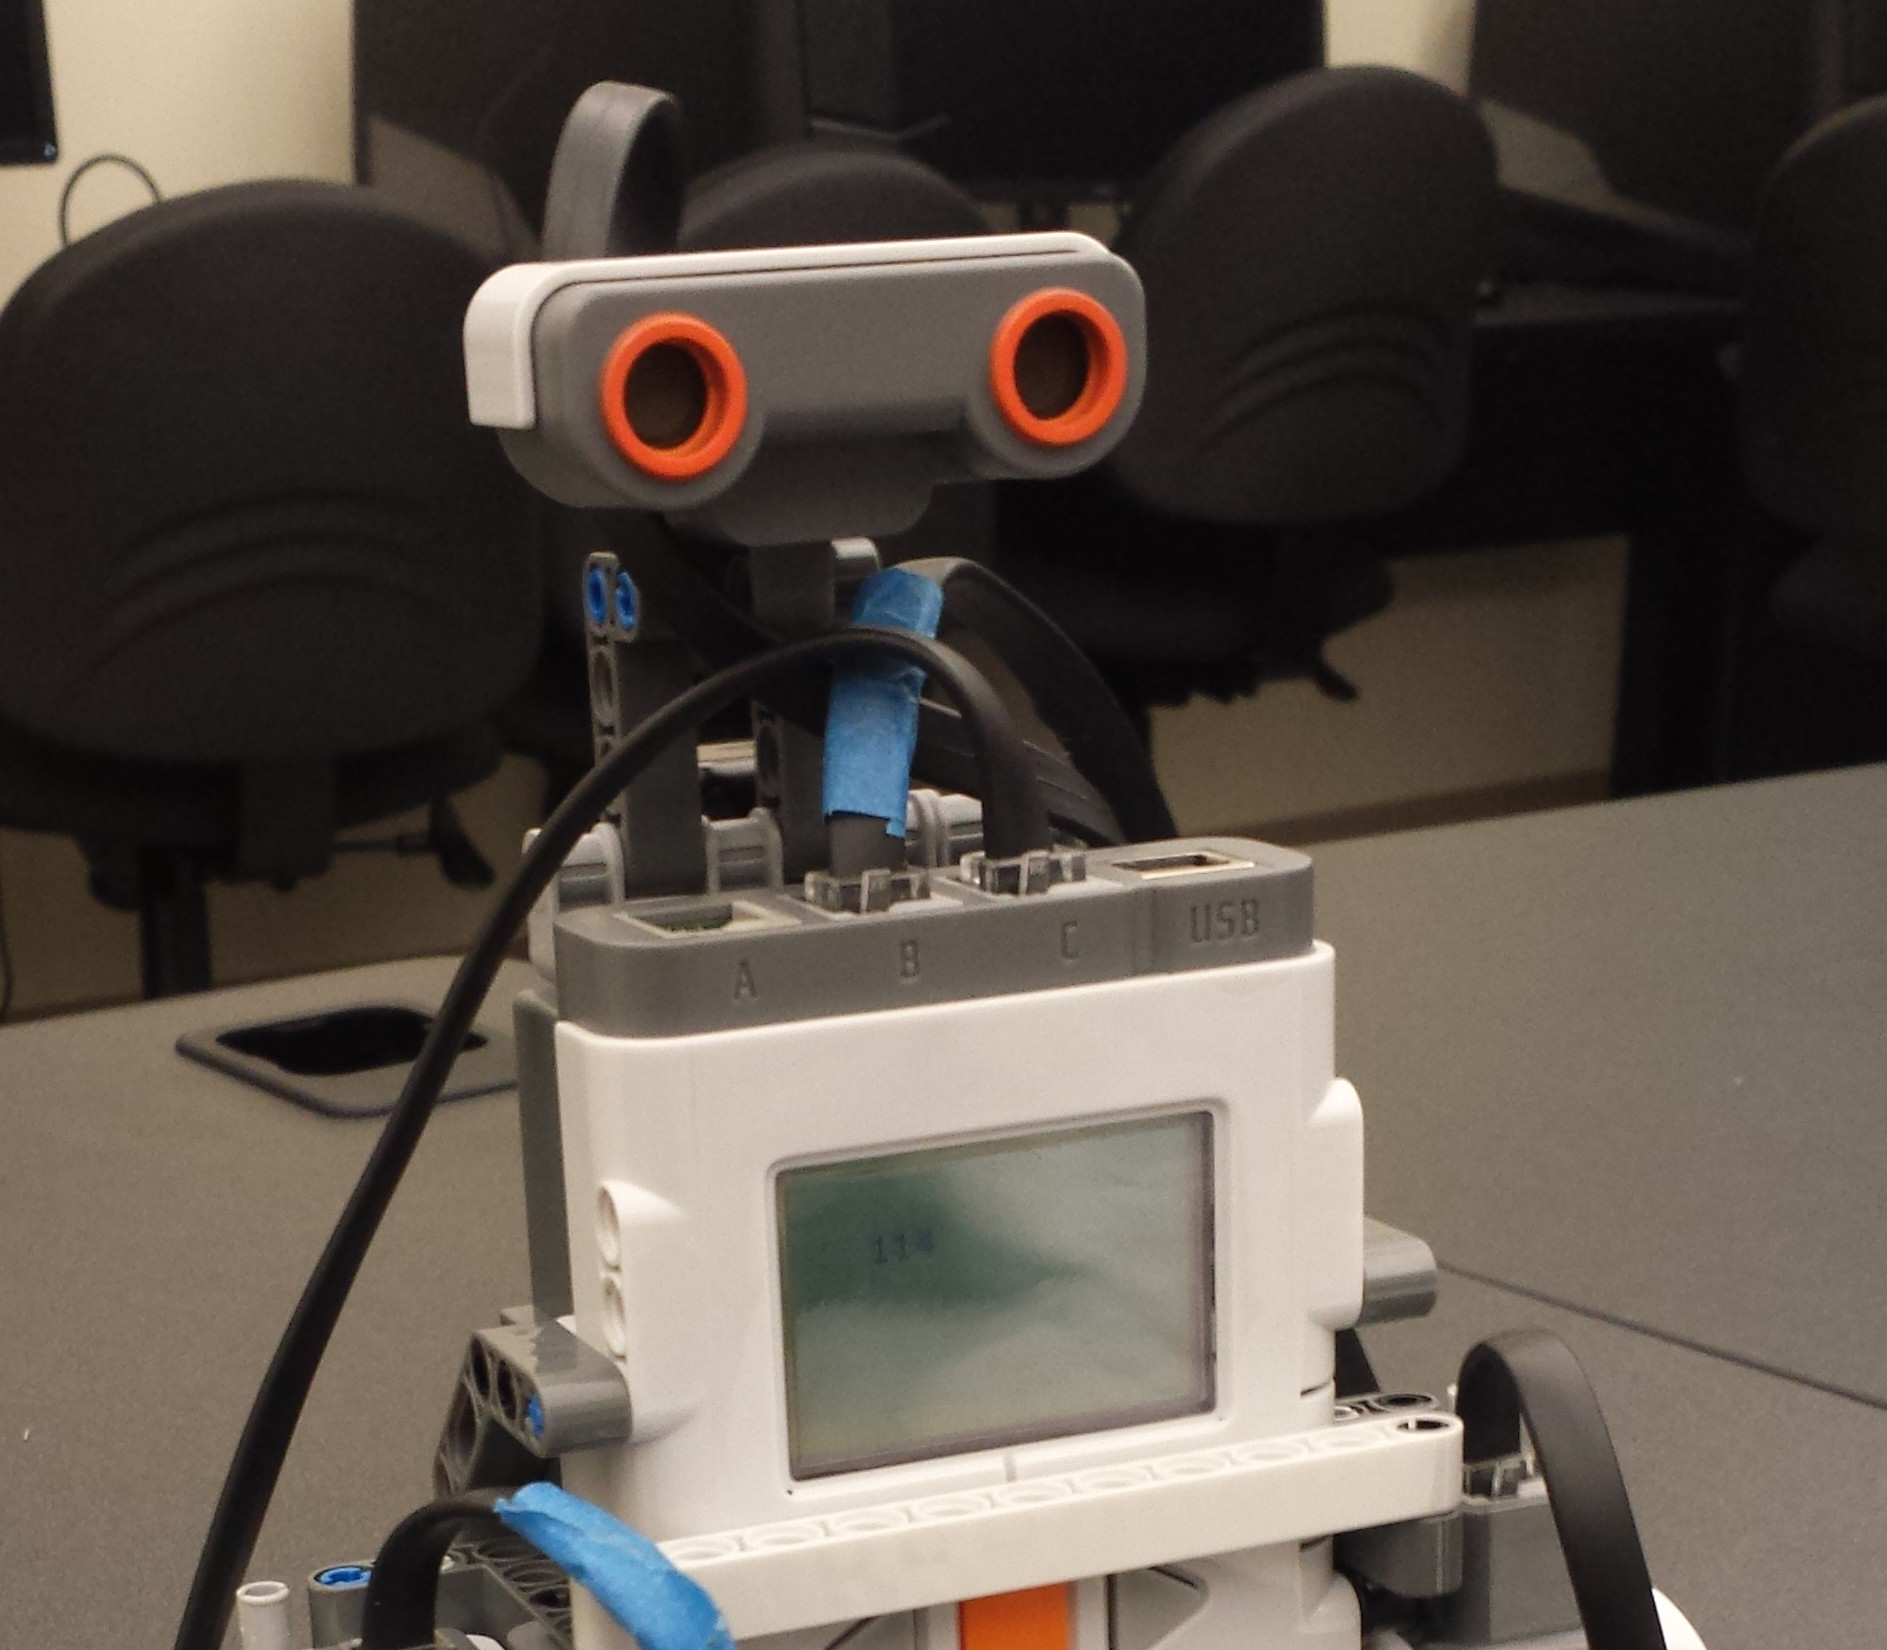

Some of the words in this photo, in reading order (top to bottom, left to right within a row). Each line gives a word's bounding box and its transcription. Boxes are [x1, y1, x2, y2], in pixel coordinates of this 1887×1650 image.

[733, 960, 758, 1000] A
[899, 939, 920, 979] B
[1060, 919, 1079, 960] C
[1189, 896, 1261, 944] USB
